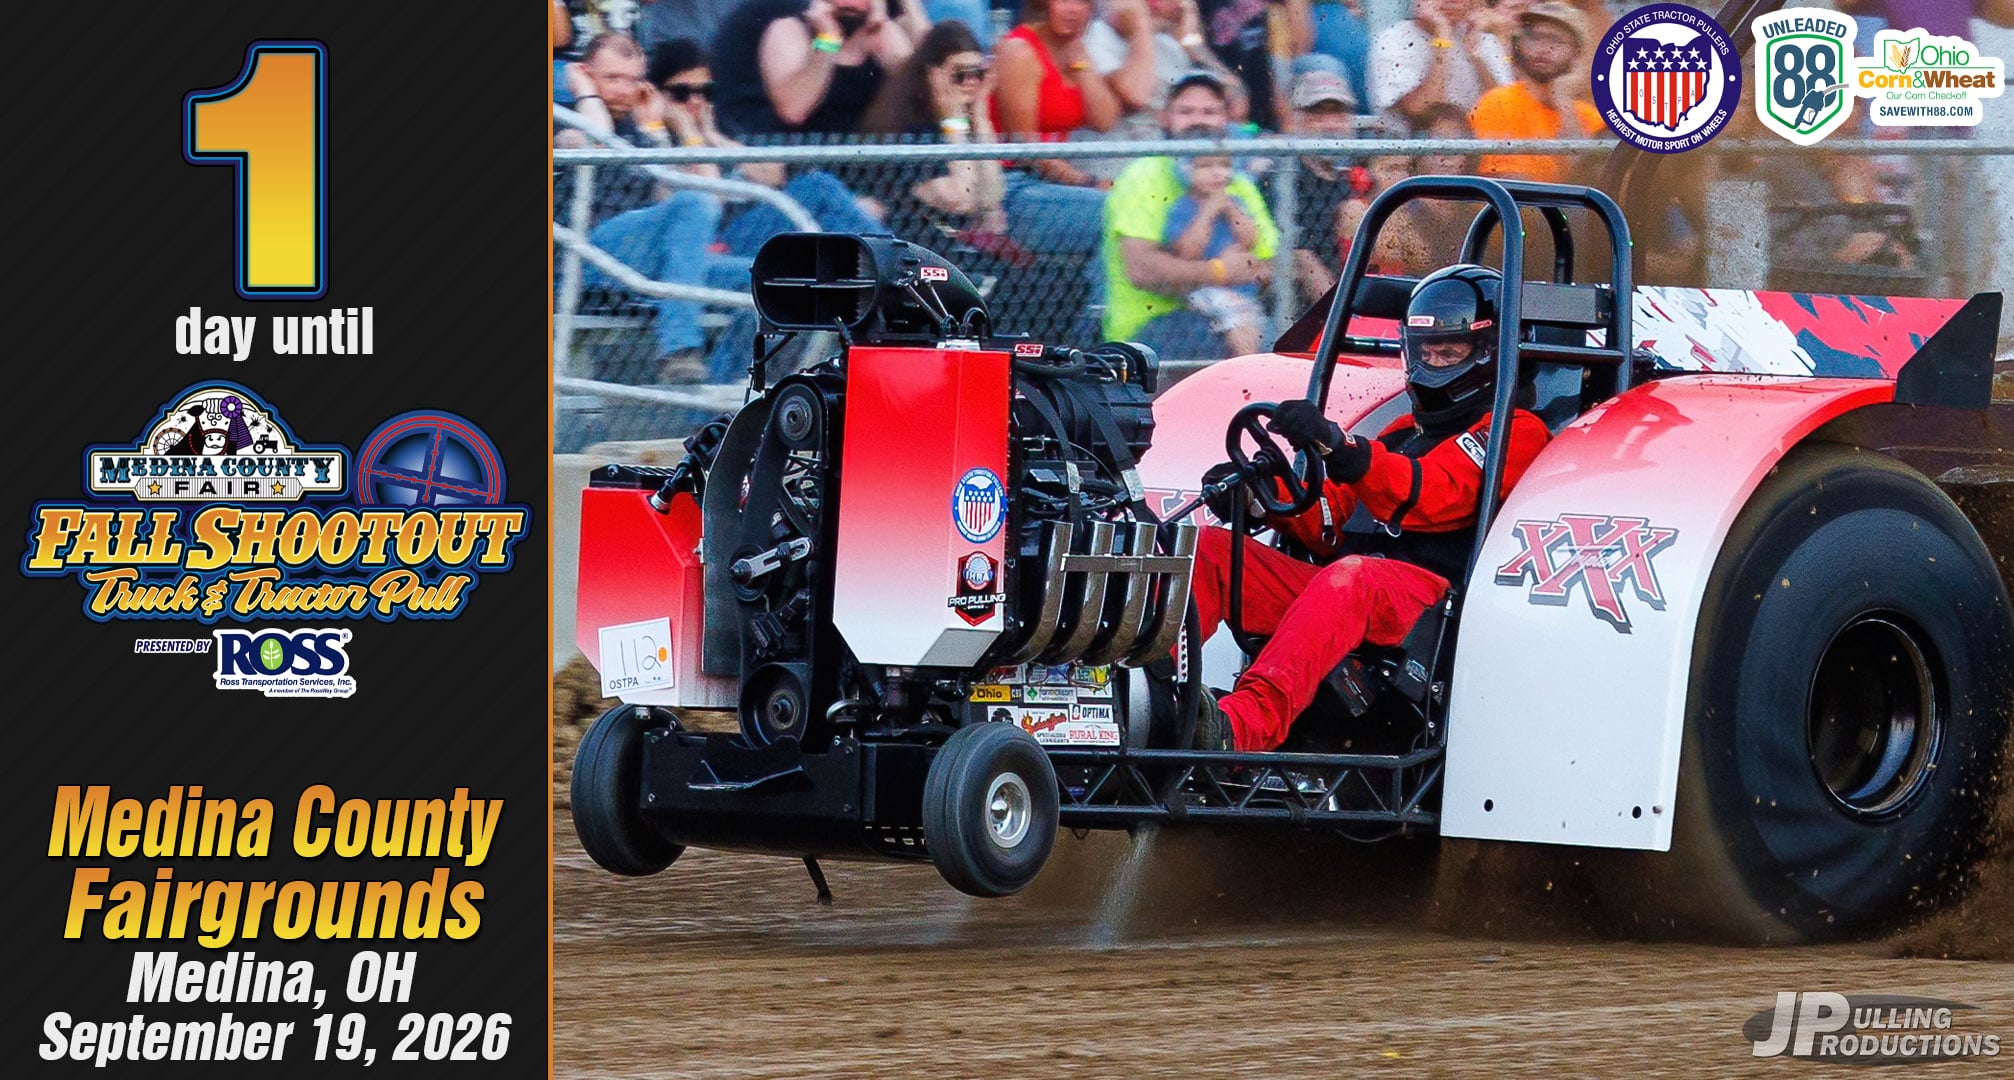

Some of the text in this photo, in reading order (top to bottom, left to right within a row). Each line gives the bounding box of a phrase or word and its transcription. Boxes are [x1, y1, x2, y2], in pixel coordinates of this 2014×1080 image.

[1494, 513, 1680, 635] XXX
[948, 593, 1007, 606] PRO PULLING
[609, 676, 640, 690] OSTPA
[976, 688, 1003, 699] Ohio
[1081, 706, 1110, 719] OPTIMA
[1069, 729, 1118, 741] RURAL KING
